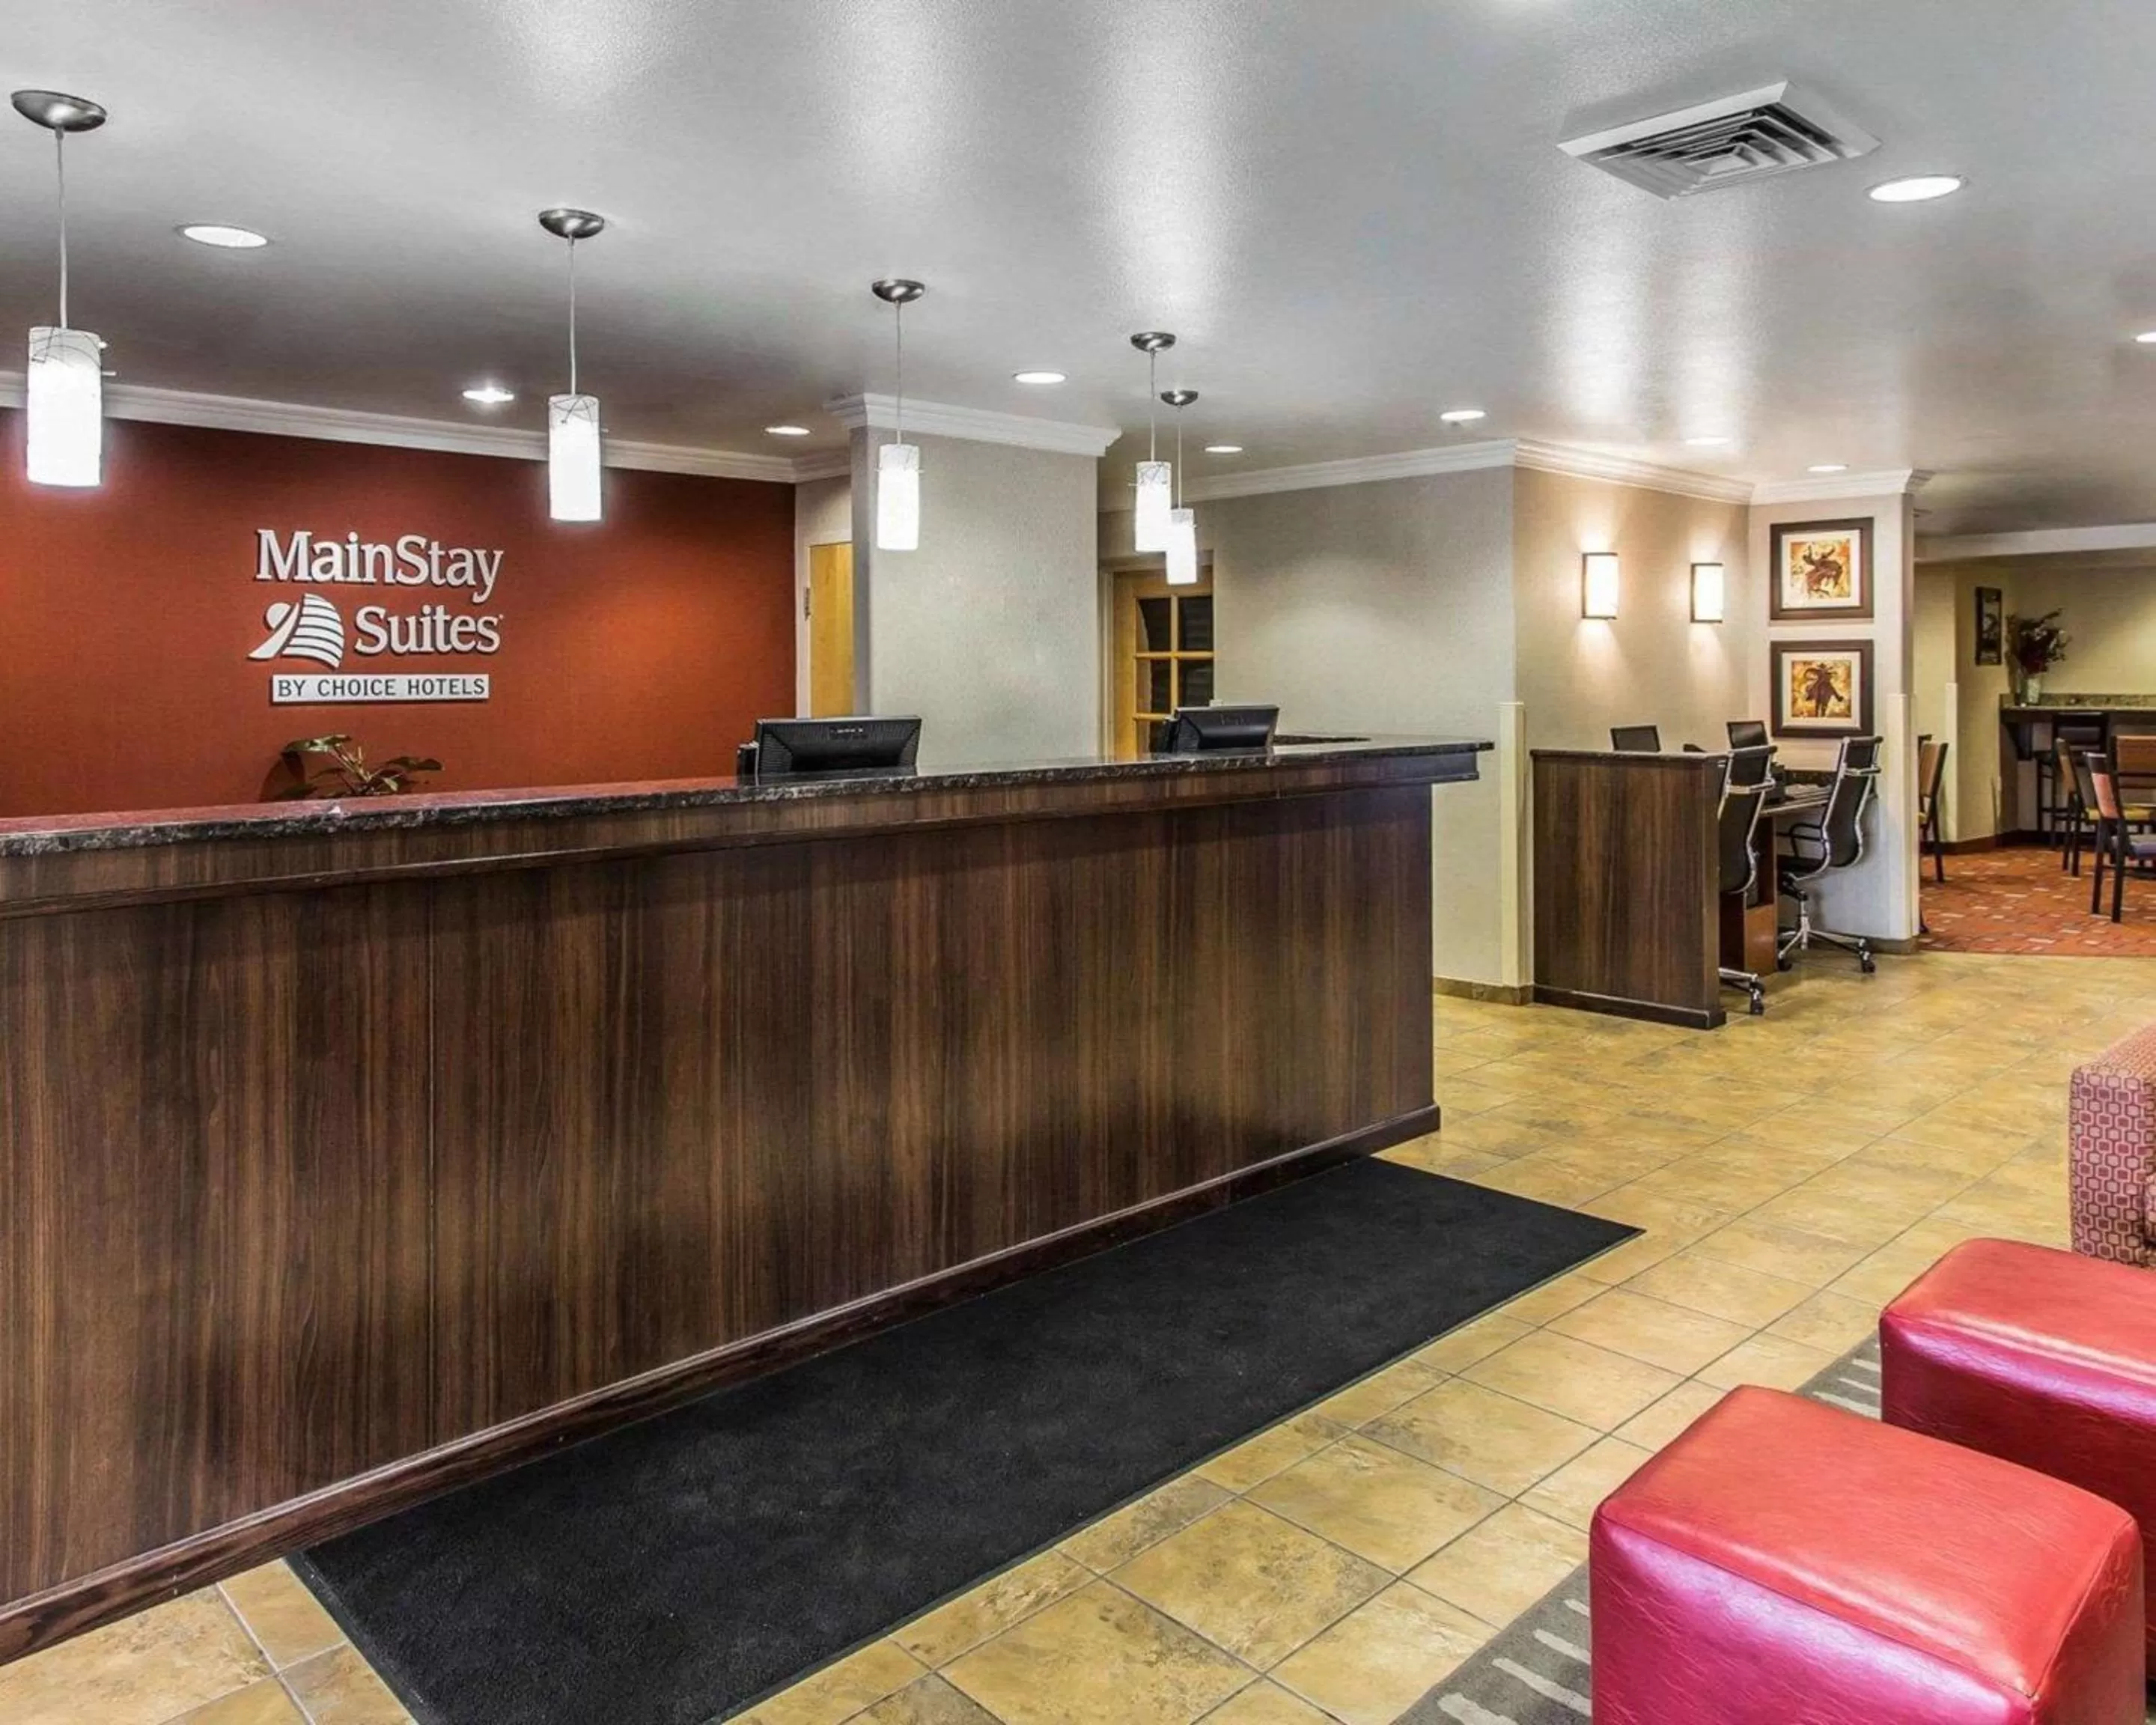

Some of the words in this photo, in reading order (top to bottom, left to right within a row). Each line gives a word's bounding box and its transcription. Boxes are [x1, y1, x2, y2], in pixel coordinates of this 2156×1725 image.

[255, 528, 504, 603] MainStay
[354, 604, 502, 654] Suites
[278, 679, 306, 696] BY
[317, 679, 395, 696] CHOICE
[408, 678, 485, 696] HOTELS
